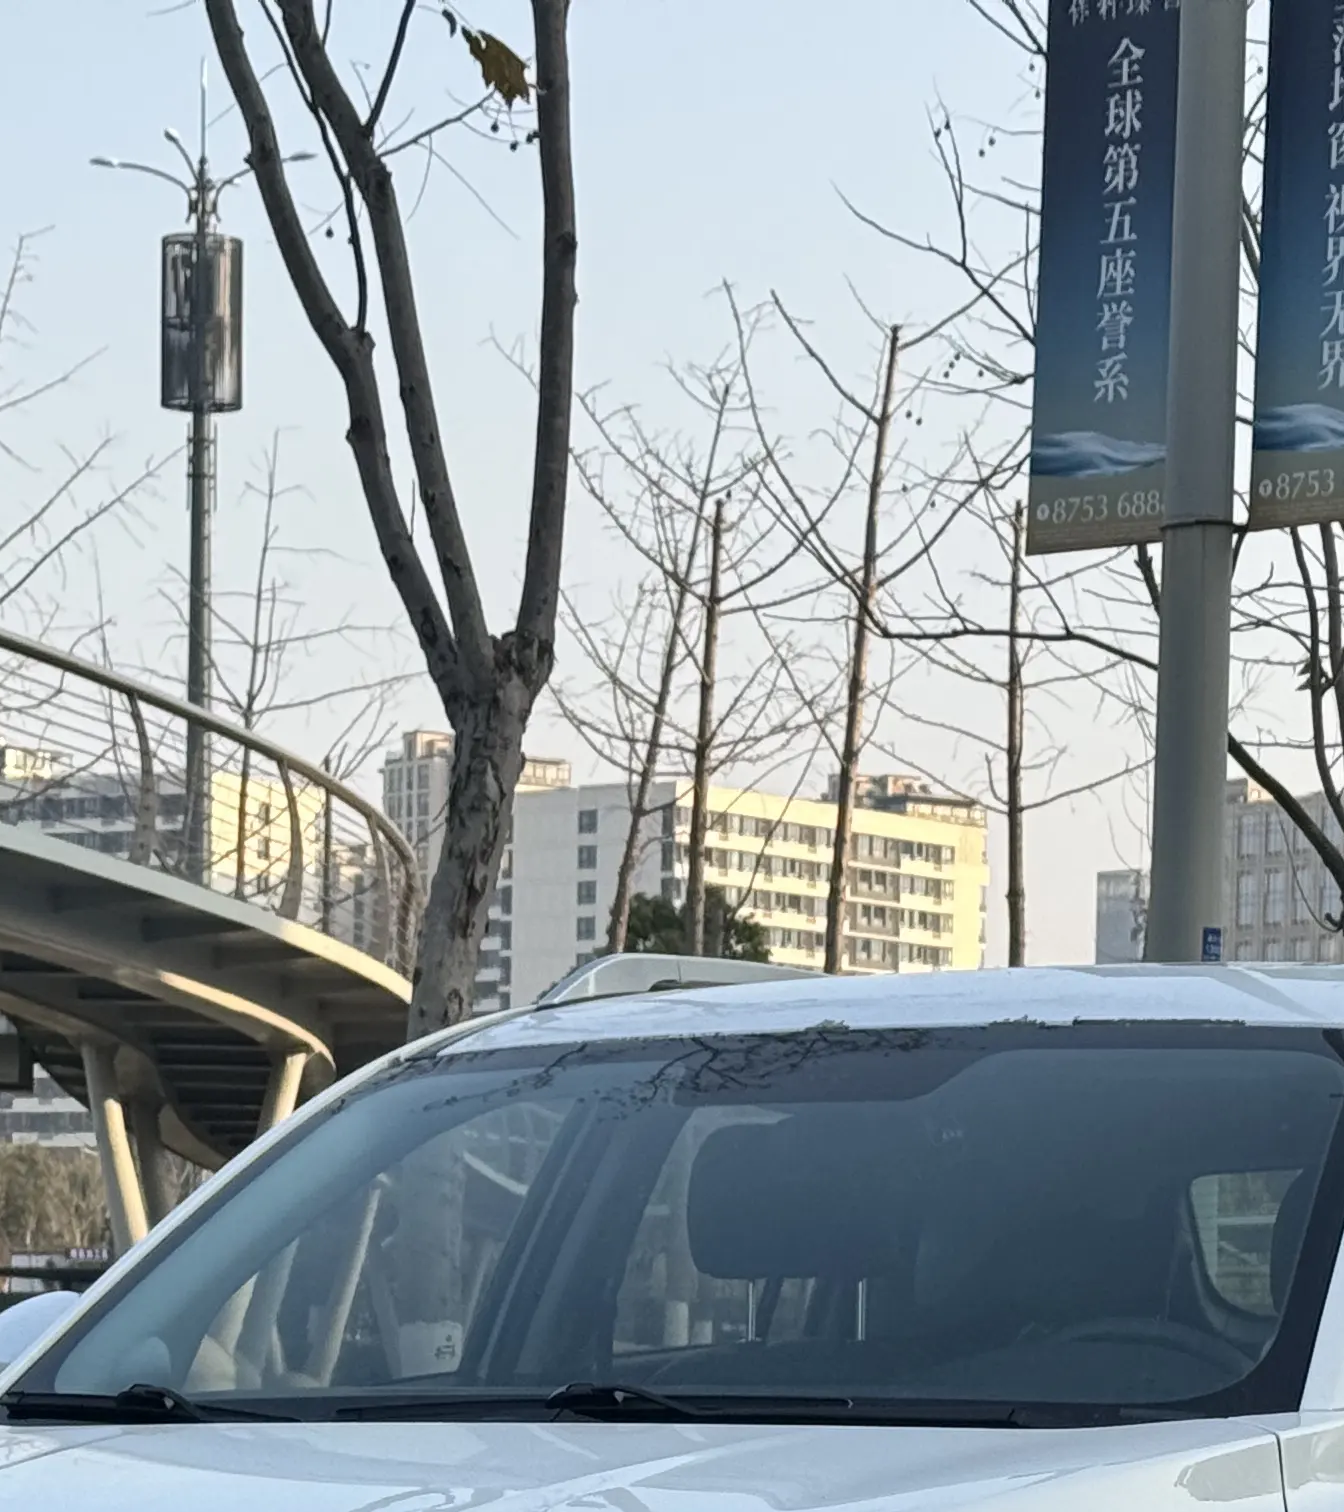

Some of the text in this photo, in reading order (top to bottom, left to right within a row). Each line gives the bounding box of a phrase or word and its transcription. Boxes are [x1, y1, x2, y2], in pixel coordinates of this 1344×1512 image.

[1093, 36, 1146, 403] 全球第五座誉系
[1275, 468, 1335, 500] 8753
[1052, 489, 1166, 524] 8753 688
